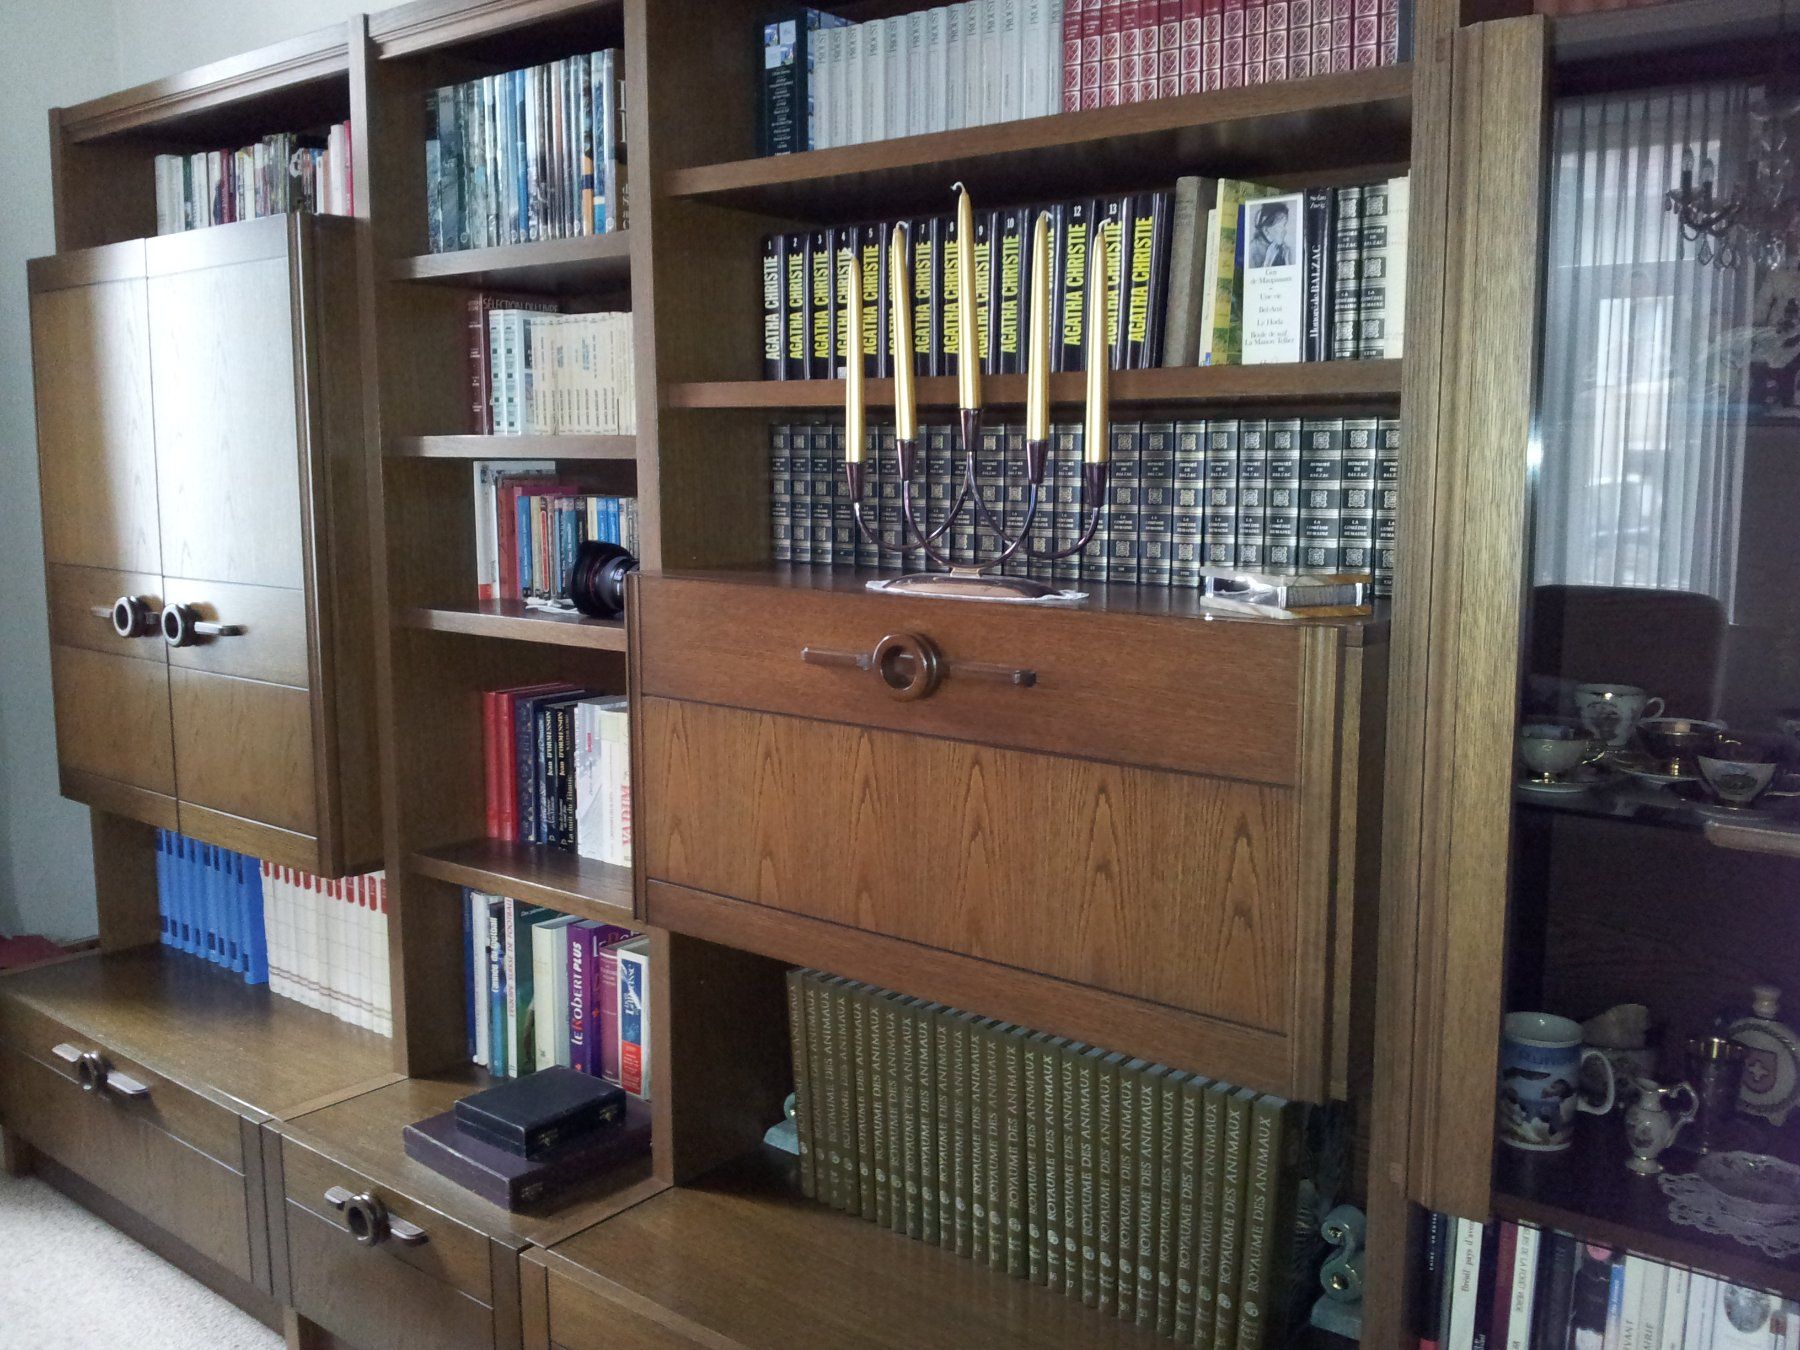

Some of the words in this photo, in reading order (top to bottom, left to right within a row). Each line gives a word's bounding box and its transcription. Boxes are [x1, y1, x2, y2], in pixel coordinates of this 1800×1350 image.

[869, 228, 873, 238] 5
[921, 224, 925, 233] 7
[950, 221, 954, 232] 8
[979, 225, 983, 236] 9
[1007, 218, 1015, 228] 10
[1074, 206, 1082, 217] 12
[1109, 203, 1117, 214] 13
[768, 241, 772, 250] 1
[793, 237, 798, 247] 2
[818, 234, 822, 244] 3
[841, 232, 846, 241] 4
[1067, 223, 1086, 287] CHRISTIE
[1132, 216, 1152, 282] CHRISTIE
[764, 255, 779, 309] CHRISTIE
[789, 252, 803, 308] CHRISTIE
[813, 250, 828, 306] CHRISTIE
[863, 244, 879, 300] CHRISTIE
[915, 241, 931, 299] CHRISTIE
[944, 239, 959, 299] CHRISTIE
[1002, 234, 1019, 296] CHRISTIE
[765, 313, 780, 360] AGATHA
[790, 312, 803, 359] AGATHA
[814, 310, 829, 358] AGATHA
[863, 305, 878, 355] AGATHA
[915, 303, 930, 354] AGATHA
[943, 302, 959, 354] AGATHA
[1001, 300, 1018, 353] AGATHA
[1064, 291, 1084, 345] AGATHA
[1128, 286, 1150, 342] AGATHA
[572, 941, 582, 972] PLUS
[919, 1021, 928, 1086] ANIMAUX
[971, 1035, 980, 1101] ANIMAUX
[1007, 1046, 1017, 1114] ANIMAUX
[920, 1090, 929, 1112] DES
[1025, 1051, 1035, 1120] ANIMAUX
[1043, 1055, 1053, 1125] ANIMAUX
[1080, 1068, 1090, 1139] ANIMAUX
[1100, 1073, 1111, 1146] ANIMAUX
[972, 1105, 980, 1129] DES
[1008, 1117, 1018, 1142] DES
[1027, 1123, 1036, 1148] DES
[1046, 1128, 1054, 1153] DES
[1121, 1079, 1132, 1151] ANIMAUX
[1141, 1086, 1152, 1158] ANIMAUX
[1182, 1096, 1195, 1170] ANIMAUX
[921, 1117, 930, 1176] ROYAUME
[972, 1134, 981, 1194] ROYAUME
[1082, 1142, 1092, 1168] DES
[1100, 1149, 1111, 1174] DES
[1120, 1154, 1132, 1180] DES
[1226, 1109, 1240, 1184] ANIMAUX
[1255, 1116, 1271, 1192] ANIMAUX
[1008, 1146, 1019, 1208] ROYAUME
[1028, 1152, 1038, 1215] ROYAUME
[1046, 1157, 1056, 1220] ROYAUME
[1141, 1161, 1152, 1187] DES
[1182, 1173, 1192, 1201] DES
[1224, 1187, 1236, 1214] DES
[1082, 1172, 1092, 1236] ROYAUME
[1100, 1179, 1110, 1243] ROYAUME
[1120, 1184, 1132, 1249] ROYAUME
[1140, 1191, 1152, 1256] ROYAUME
[1253, 1196, 1266, 1222] DES
[1180, 1204, 1192, 1270] ROYAUME
[1220, 1217, 1235, 1284] ROYAUME
[1248, 1226, 1264, 1293] ROYAUME
[1466, 1248, 1474, 1266] pays
